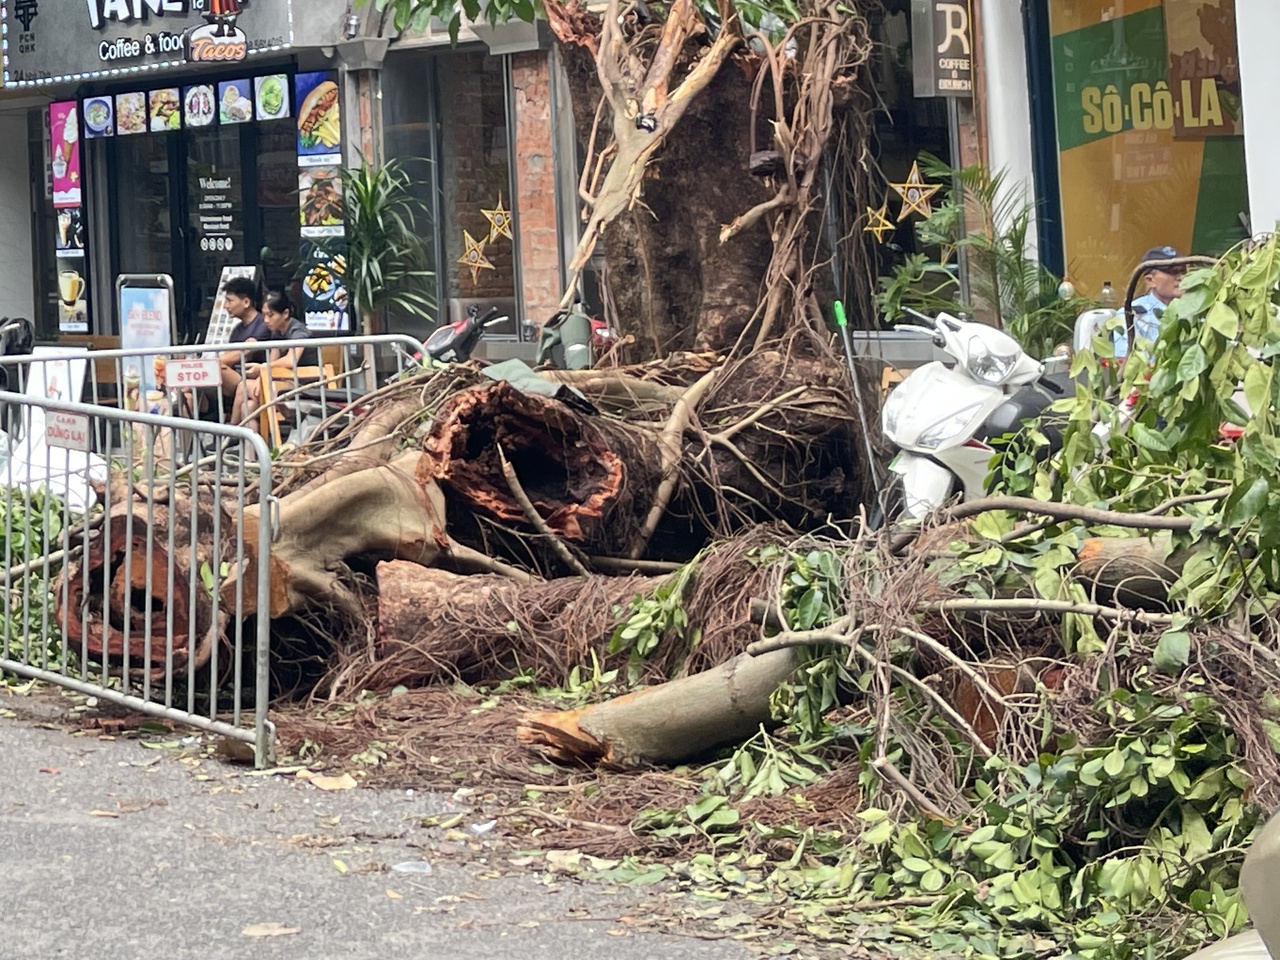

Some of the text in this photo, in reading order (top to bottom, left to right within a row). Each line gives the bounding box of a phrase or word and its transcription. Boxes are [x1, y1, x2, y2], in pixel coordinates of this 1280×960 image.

[935, 2, 970, 55] R
[99, 37, 140, 61] Coffee
[144, 33, 155, 55] &
[190, 36, 248, 62] Tacos
[938, 58, 970, 71] COFFEE
[177, 371, 209, 382] STOP
